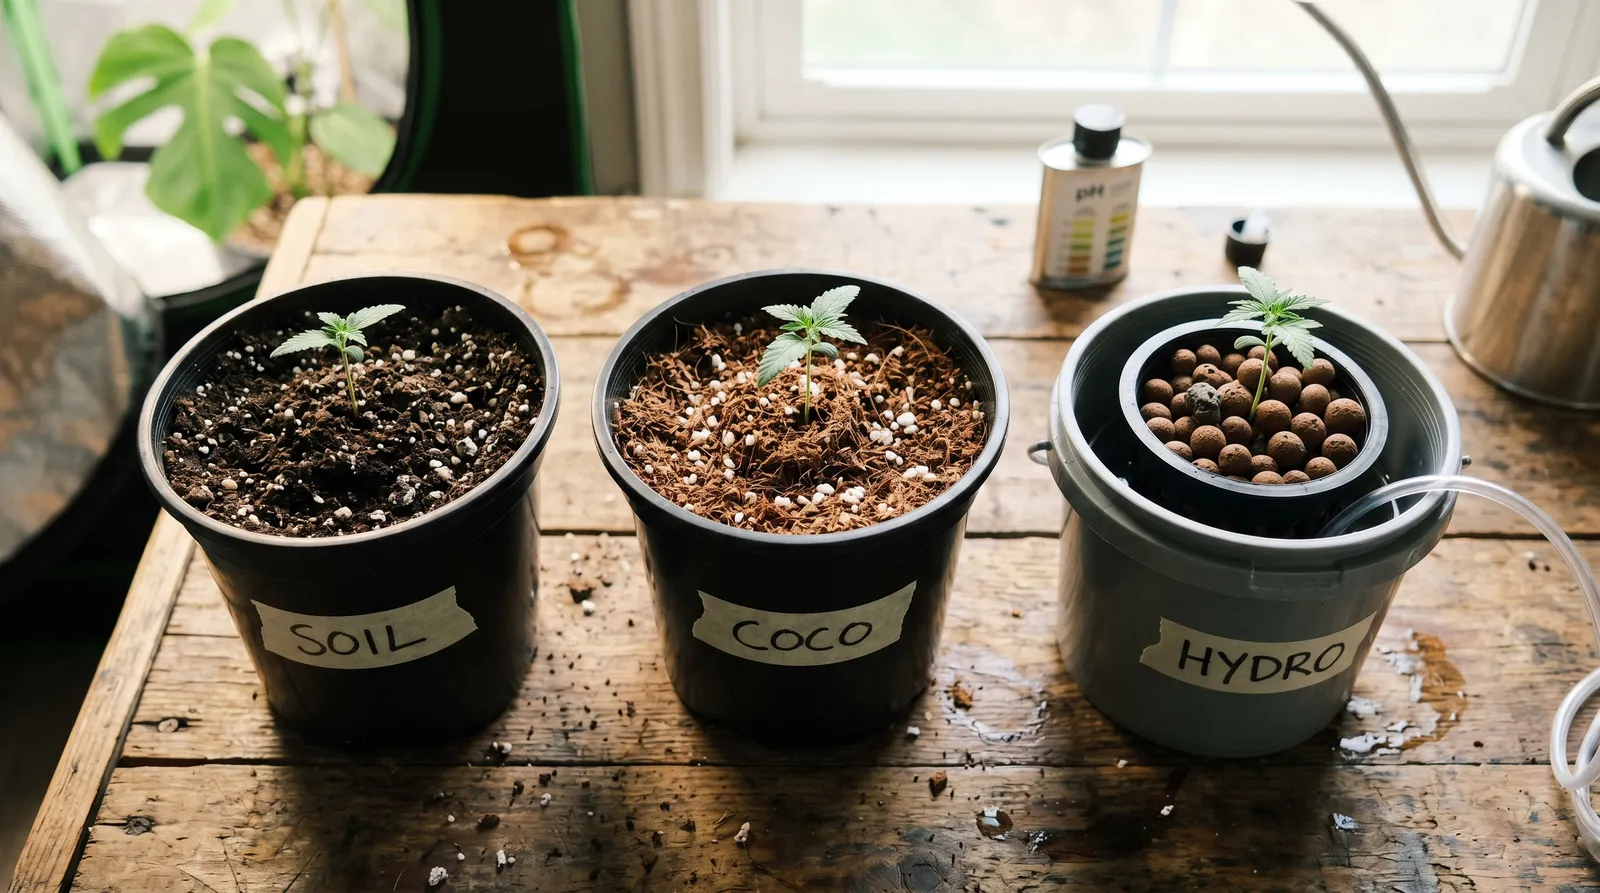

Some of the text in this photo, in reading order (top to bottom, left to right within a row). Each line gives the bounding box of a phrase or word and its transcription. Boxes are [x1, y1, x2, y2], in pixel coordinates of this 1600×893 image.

[1075, 184, 1105, 201] pH
[289, 623, 427, 656] SOIL
[732, 620, 873, 651] COCO
[1178, 639, 1345, 685] HYDRO
